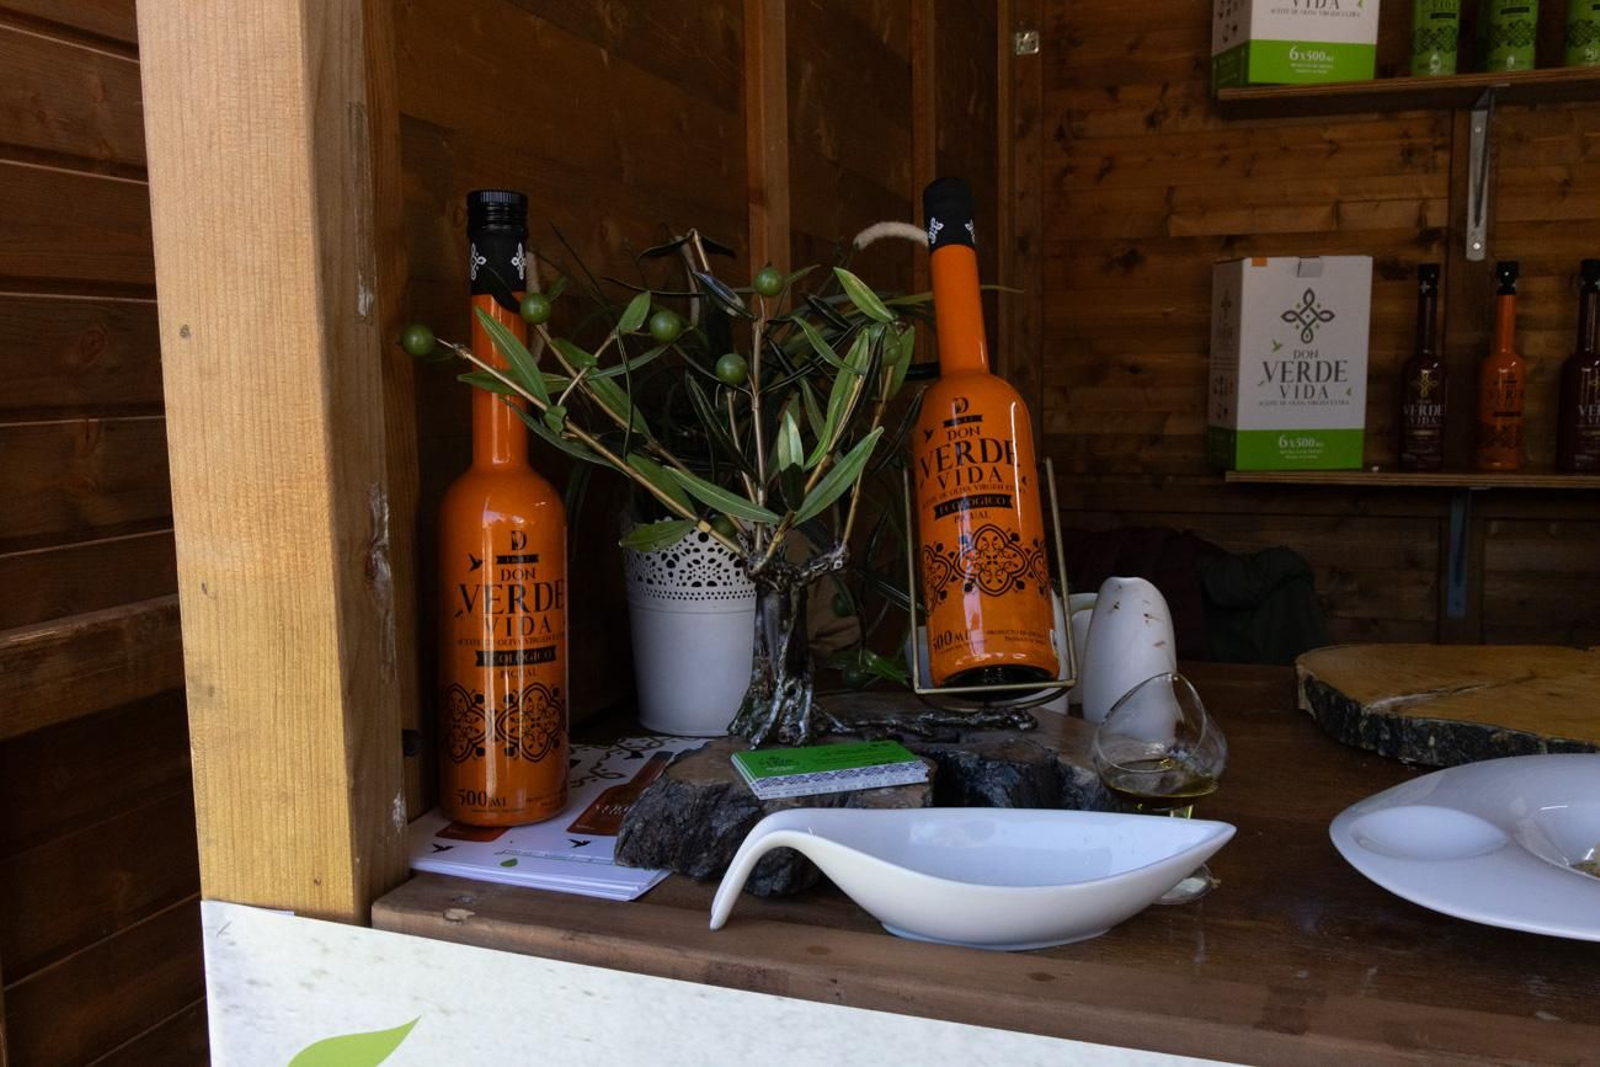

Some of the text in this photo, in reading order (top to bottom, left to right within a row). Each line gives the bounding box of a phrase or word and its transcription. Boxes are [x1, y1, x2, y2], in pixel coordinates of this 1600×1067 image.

[1263, 360, 1348, 383] VERDE
[1280, 384, 1329, 400] VIDA
[1402, 404, 1442, 416] VERDE
[948, 427, 981, 441] DON
[920, 438, 1021, 480] VERDE
[937, 466, 1003, 490] VIDA
[501, 568, 536, 581] DON
[459, 579, 565, 615] VERDE
[485, 616, 552, 637] VIDA
